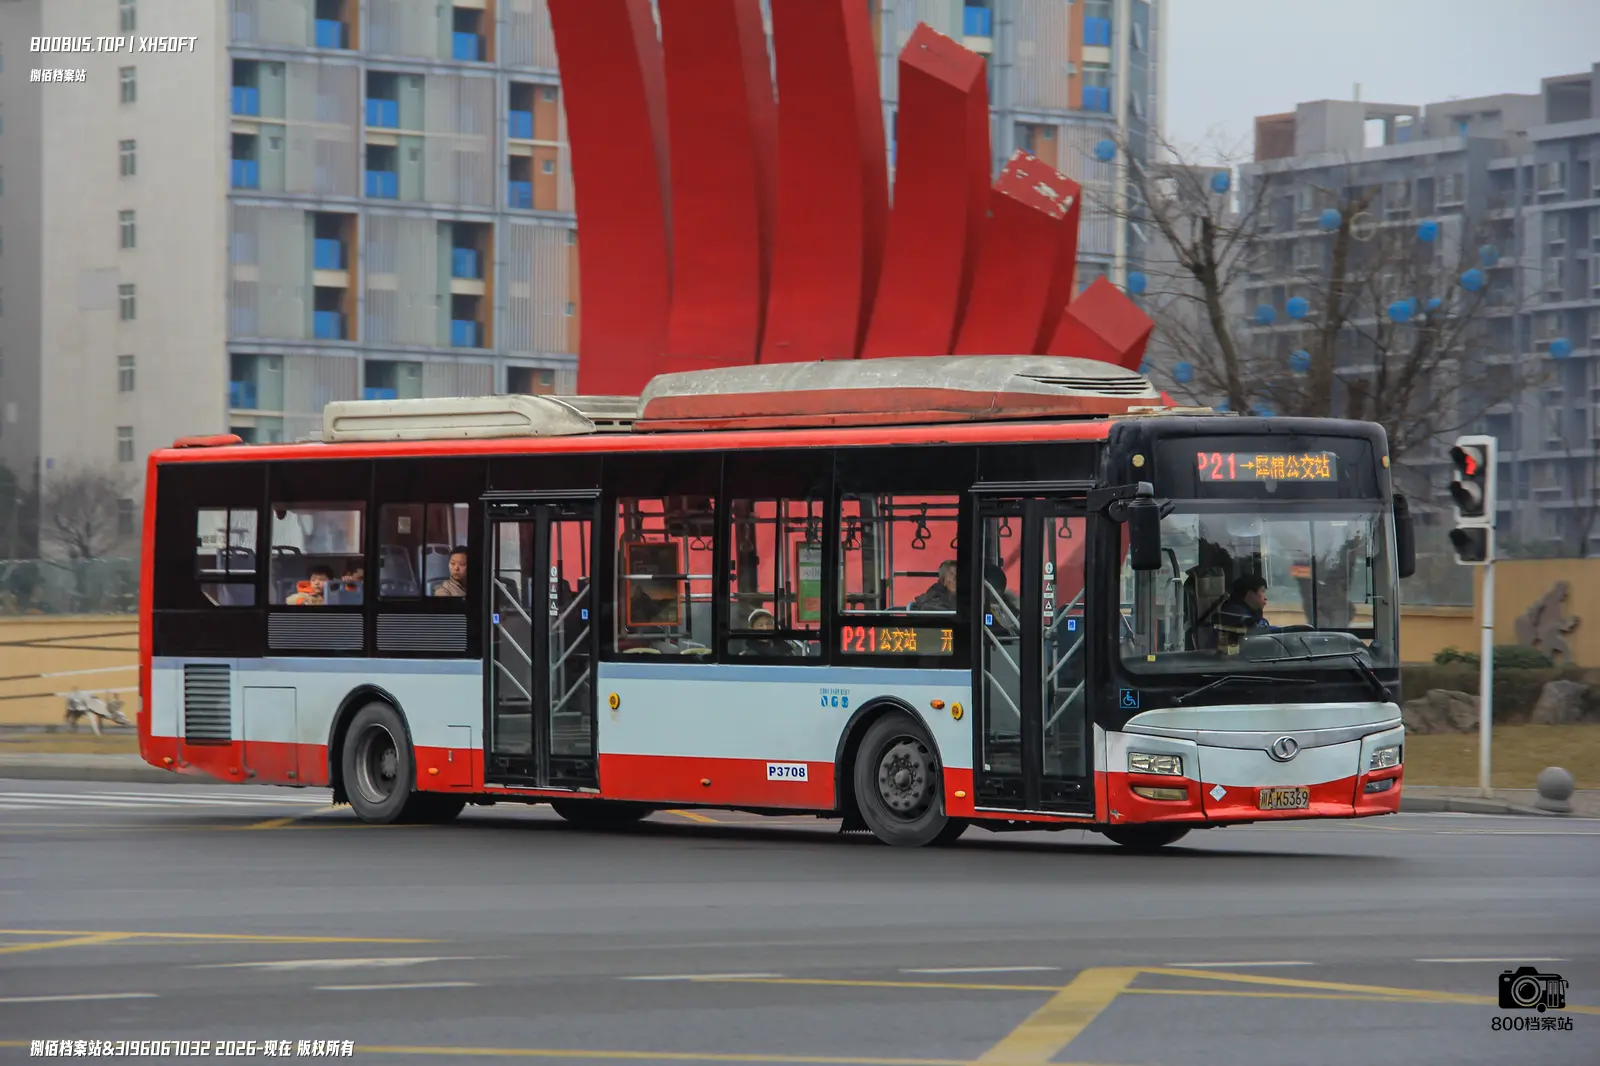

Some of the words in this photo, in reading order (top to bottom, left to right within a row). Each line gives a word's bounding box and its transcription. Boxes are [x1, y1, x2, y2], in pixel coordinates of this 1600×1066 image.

[1197, 452, 1236, 480] P21
[842, 626, 876, 652] P21
[879, 627, 917, 652] 公交站
[768, 766, 806, 778] P3708
